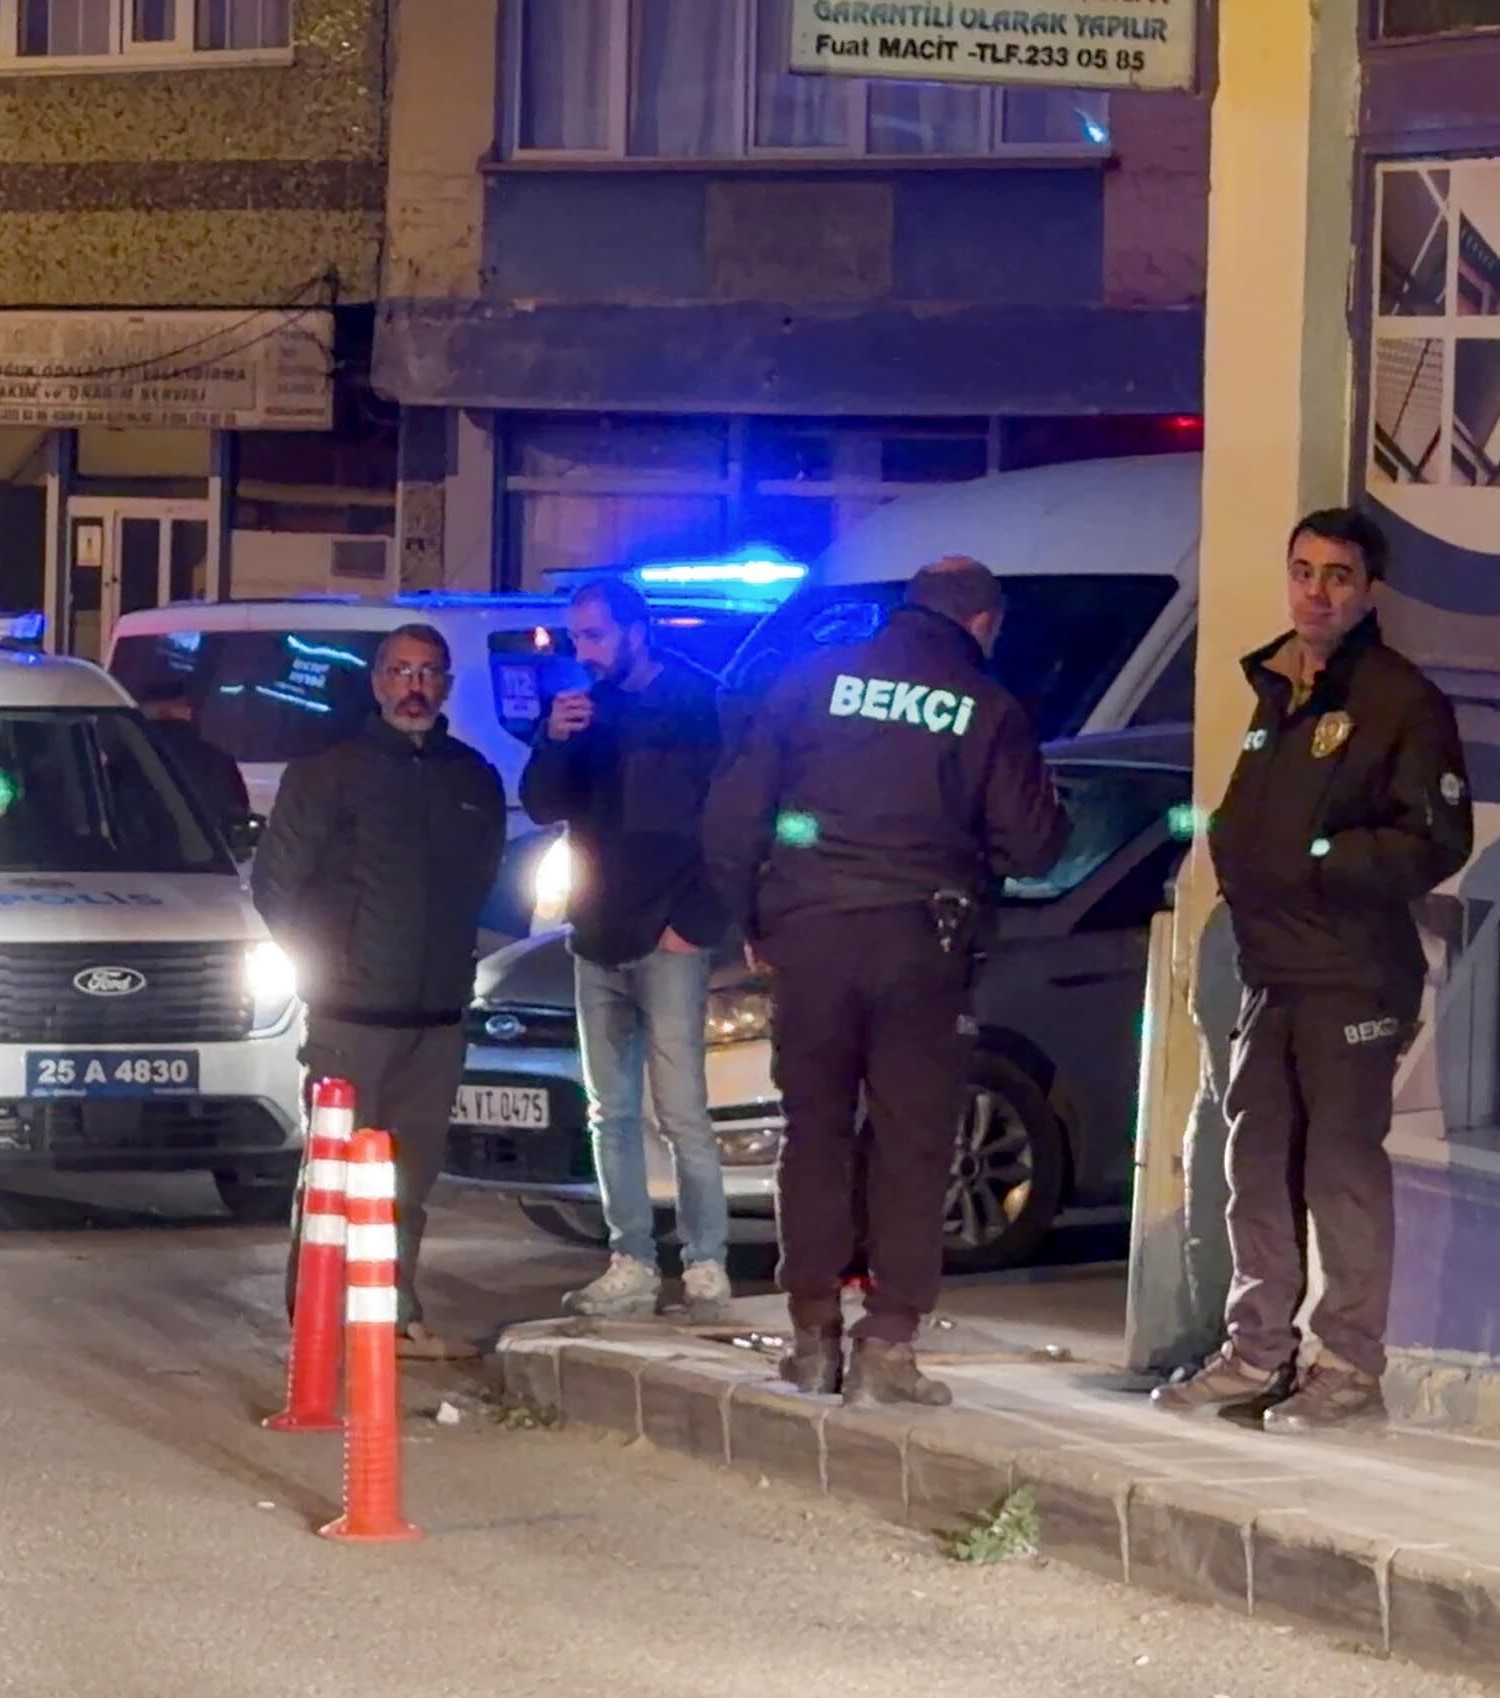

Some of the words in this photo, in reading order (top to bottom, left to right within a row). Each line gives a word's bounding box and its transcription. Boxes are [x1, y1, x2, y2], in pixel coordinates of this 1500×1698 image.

[813, 0, 954, 28] GARANTİLİ
[960, 7, 1067, 35] OLARAK
[1074, 14, 1168, 42] YAPILIR
[816, 34, 869, 57] Fuat
[879, 35, 958, 61] MACİT
[1077, 48, 1107, 69] 05
[1116, 49, 1145, 71] 85
[829, 673, 976, 736] BEKÇİ
[37, 1058, 77, 1085] 25
[83, 1058, 108, 1084] A
[113, 1058, 190, 1085] 4830
[500, 1091, 543, 1122] 0475
